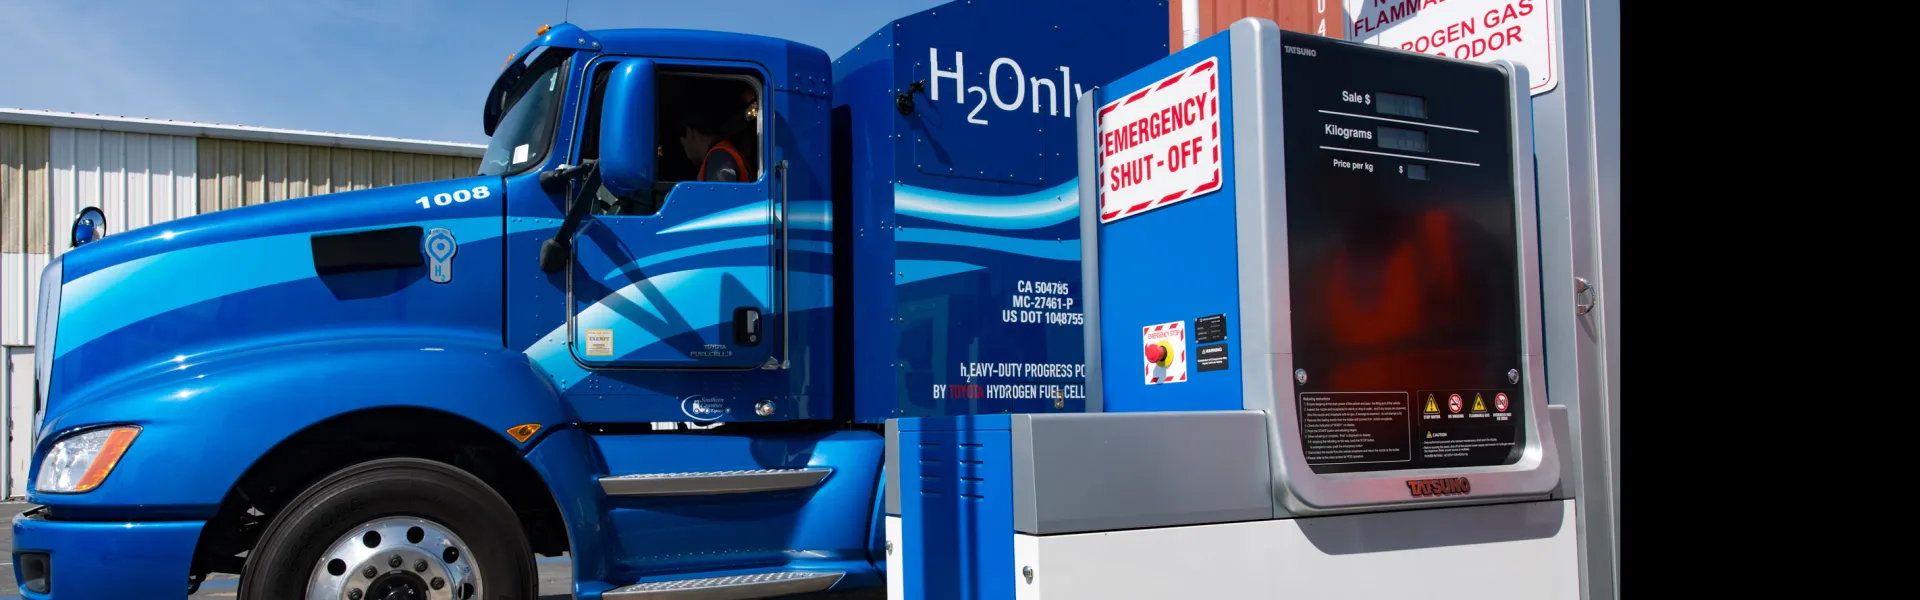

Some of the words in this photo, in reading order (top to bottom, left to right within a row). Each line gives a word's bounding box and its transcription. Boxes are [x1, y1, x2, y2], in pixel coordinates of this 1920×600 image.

[1354, 0, 1446, 37] FLAMMA
[1484, 0, 1534, 29] GAS
[1455, 25, 1523, 60] ODOR
[1284, 45, 1317, 57] TATSUNO
[930, 47, 1083, 125] H2Onl
[1342, 90, 1362, 103] Sale
[1364, 94, 1371, 105] $
[1105, 92, 1208, 157] EMERGENCY
[1325, 123, 1372, 140] Kilograms
[1333, 159, 1350, 169] Price
[1352, 162, 1363, 171] per
[1364, 162, 1374, 172] kg
[1399, 165, 1404, 174] $
[415, 185, 491, 209] 1008
[1017, 280, 1033, 293] CA
[1035, 281, 1069, 295] 504785
[1012, 295, 1073, 309] MC-27461-P
[1002, 310, 1018, 322] US
[1020, 311, 1042, 323] DOT
[1045, 312, 1084, 325] 1048755
[1148, 331, 1170, 340] EMERGENCY
[1169, 329, 1181, 337] STOP
[1025, 363, 1073, 378] PROGRESS
[933, 384, 947, 399] BY
[948, 384, 984, 399] TOYOTA
[986, 384, 1036, 399] HYDROGEN
[1039, 384, 1061, 399] FUEL
[1064, 384, 1085, 399] CELL
[1406, 476, 1471, 497] TATSUNO
